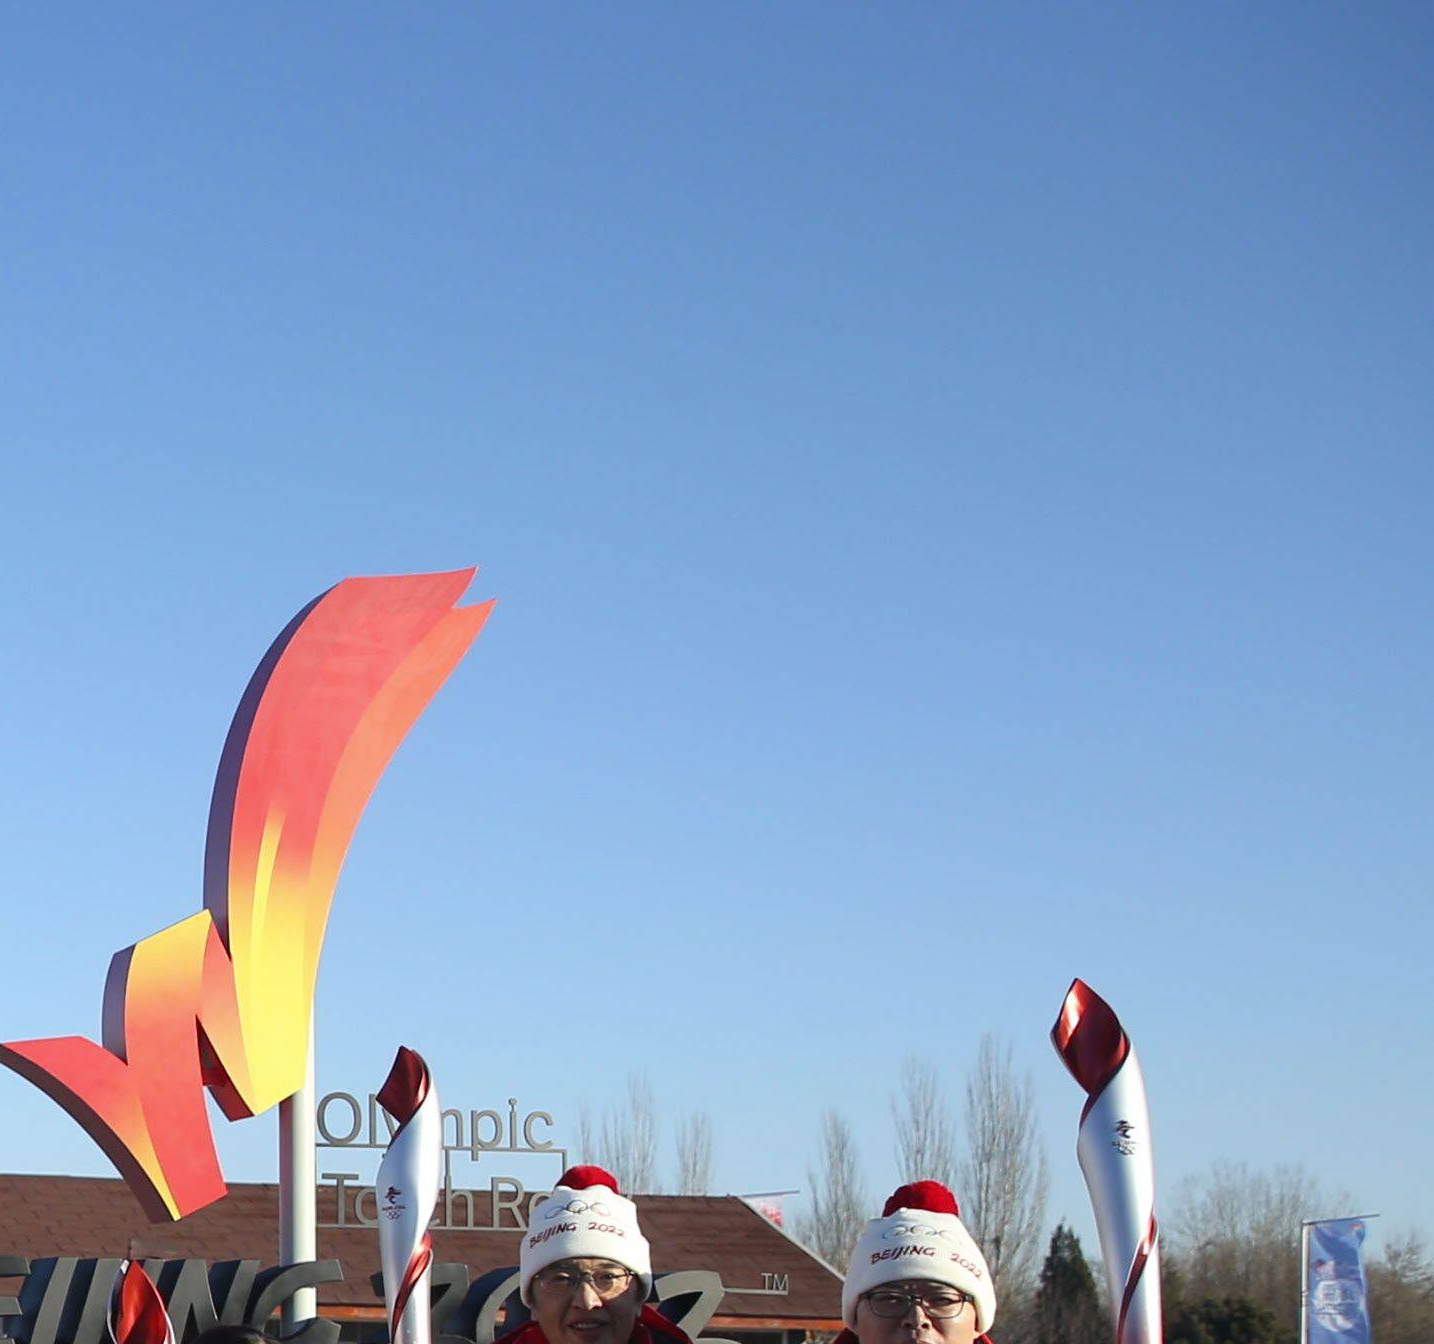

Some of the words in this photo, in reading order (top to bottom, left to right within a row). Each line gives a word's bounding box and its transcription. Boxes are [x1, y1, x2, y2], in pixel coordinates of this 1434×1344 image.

[530, 1222, 578, 1248] BEIJING
[587, 1222, 626, 1238] 2022
[871, 1245, 937, 1265] BEIJING
[949, 1253, 982, 1279] 2022
[761, 1272, 789, 1295] TM
